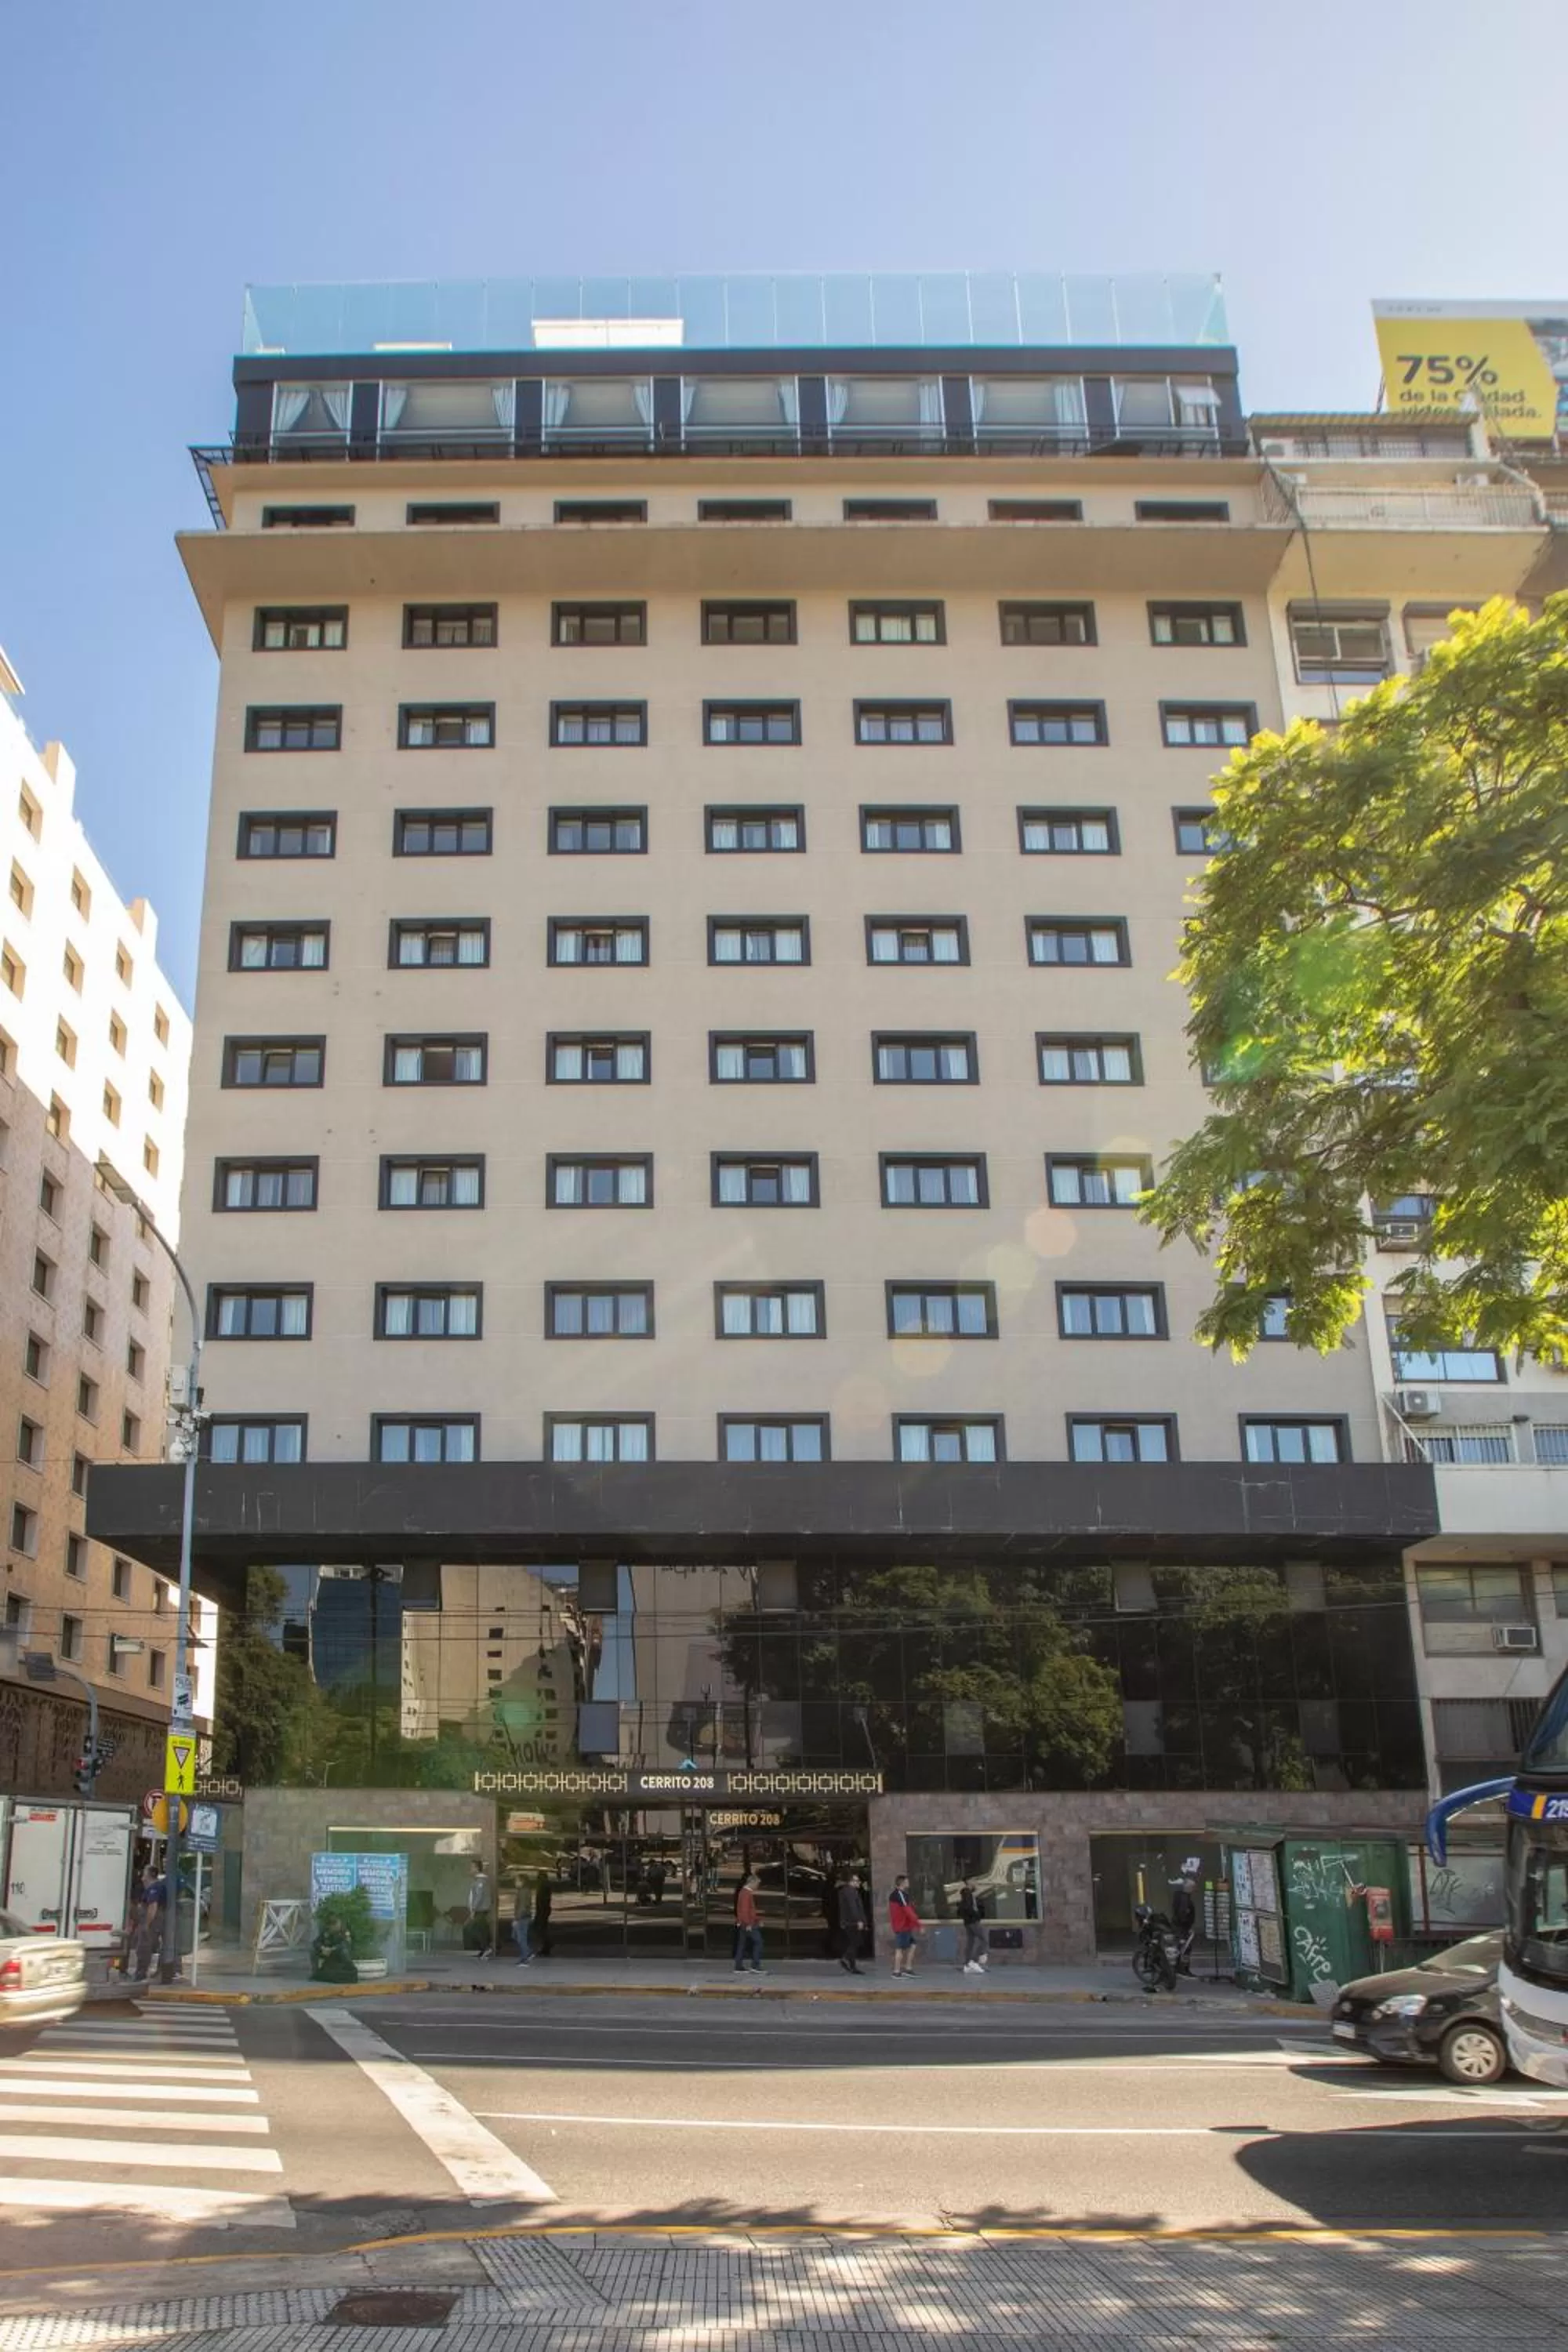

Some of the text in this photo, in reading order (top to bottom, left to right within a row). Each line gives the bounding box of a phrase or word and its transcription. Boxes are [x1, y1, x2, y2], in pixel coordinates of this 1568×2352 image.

[1396, 355, 1498, 385] 75%
[1399, 390, 1424, 402] de
[1431, 389, 1448, 402] la
[640, 1776, 715, 1788] CERRITO 208
[709, 1813, 781, 1825] CERRITO 208
